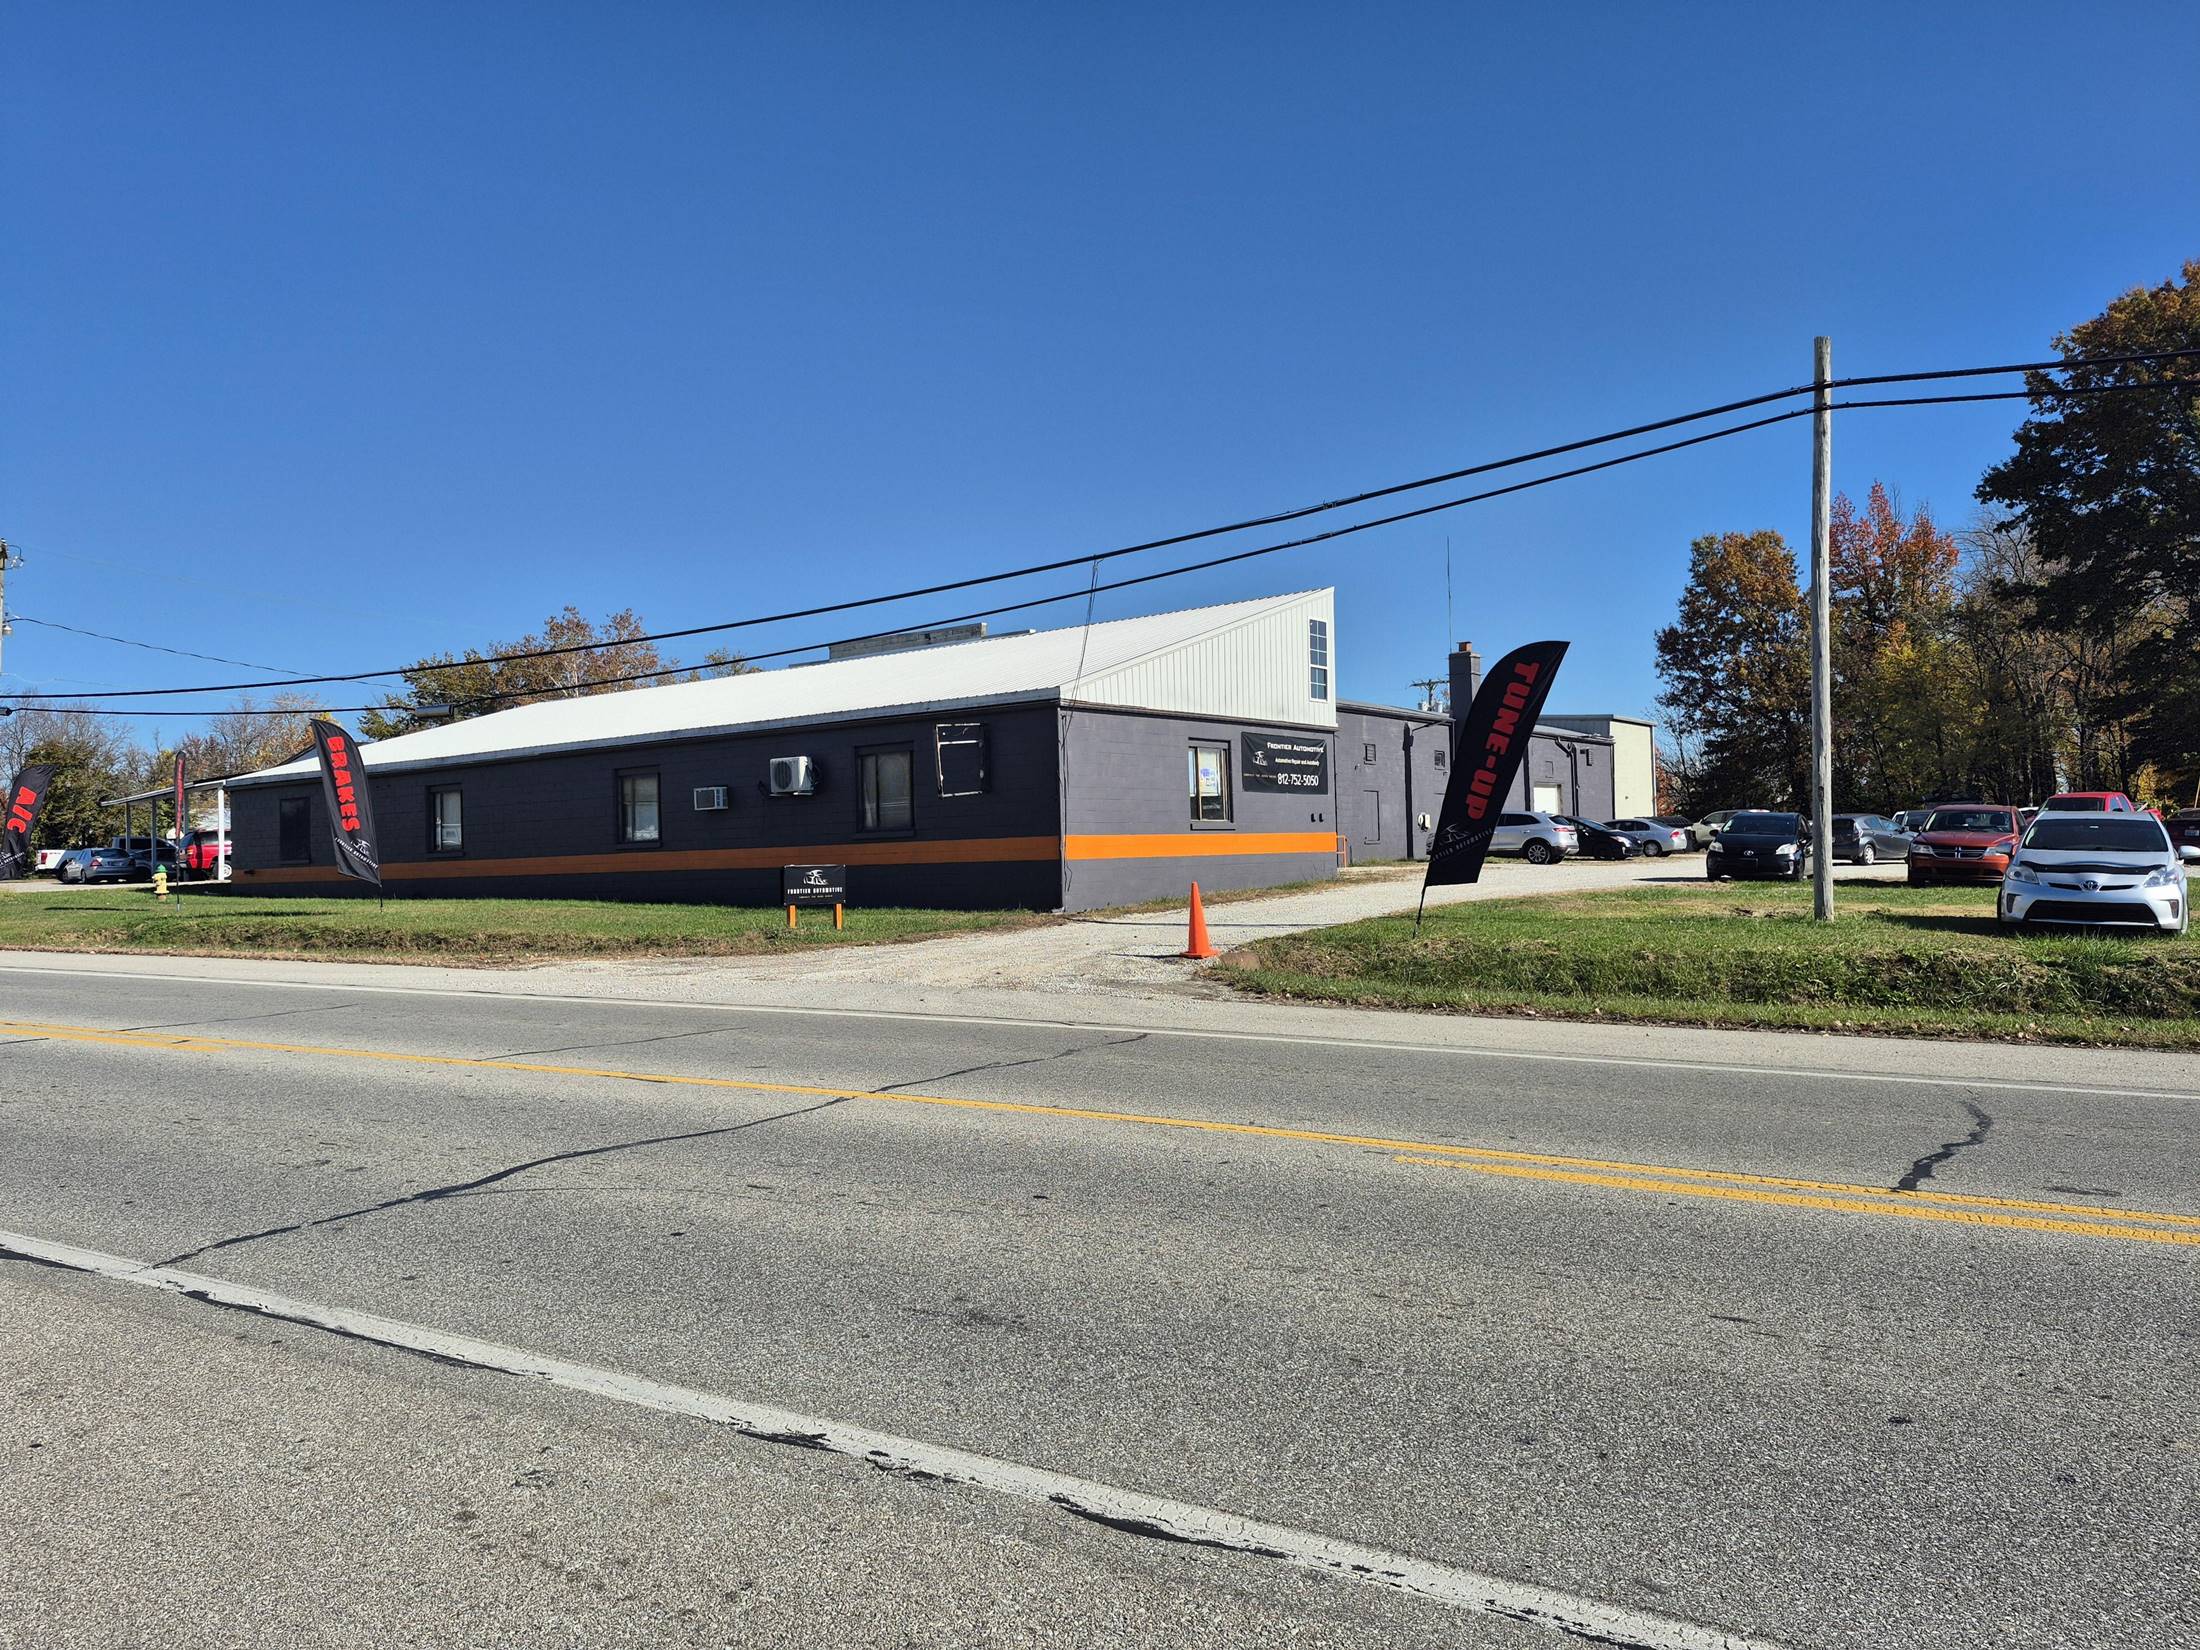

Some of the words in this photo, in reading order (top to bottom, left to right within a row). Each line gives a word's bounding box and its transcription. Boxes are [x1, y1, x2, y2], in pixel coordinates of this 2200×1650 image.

[1466, 662, 1540, 820] TUNE-UP
[7, 786, 37, 833] A/C
[327, 736, 361, 832] BRAKES
[1277, 773, 1319, 786] 812-752-5050
